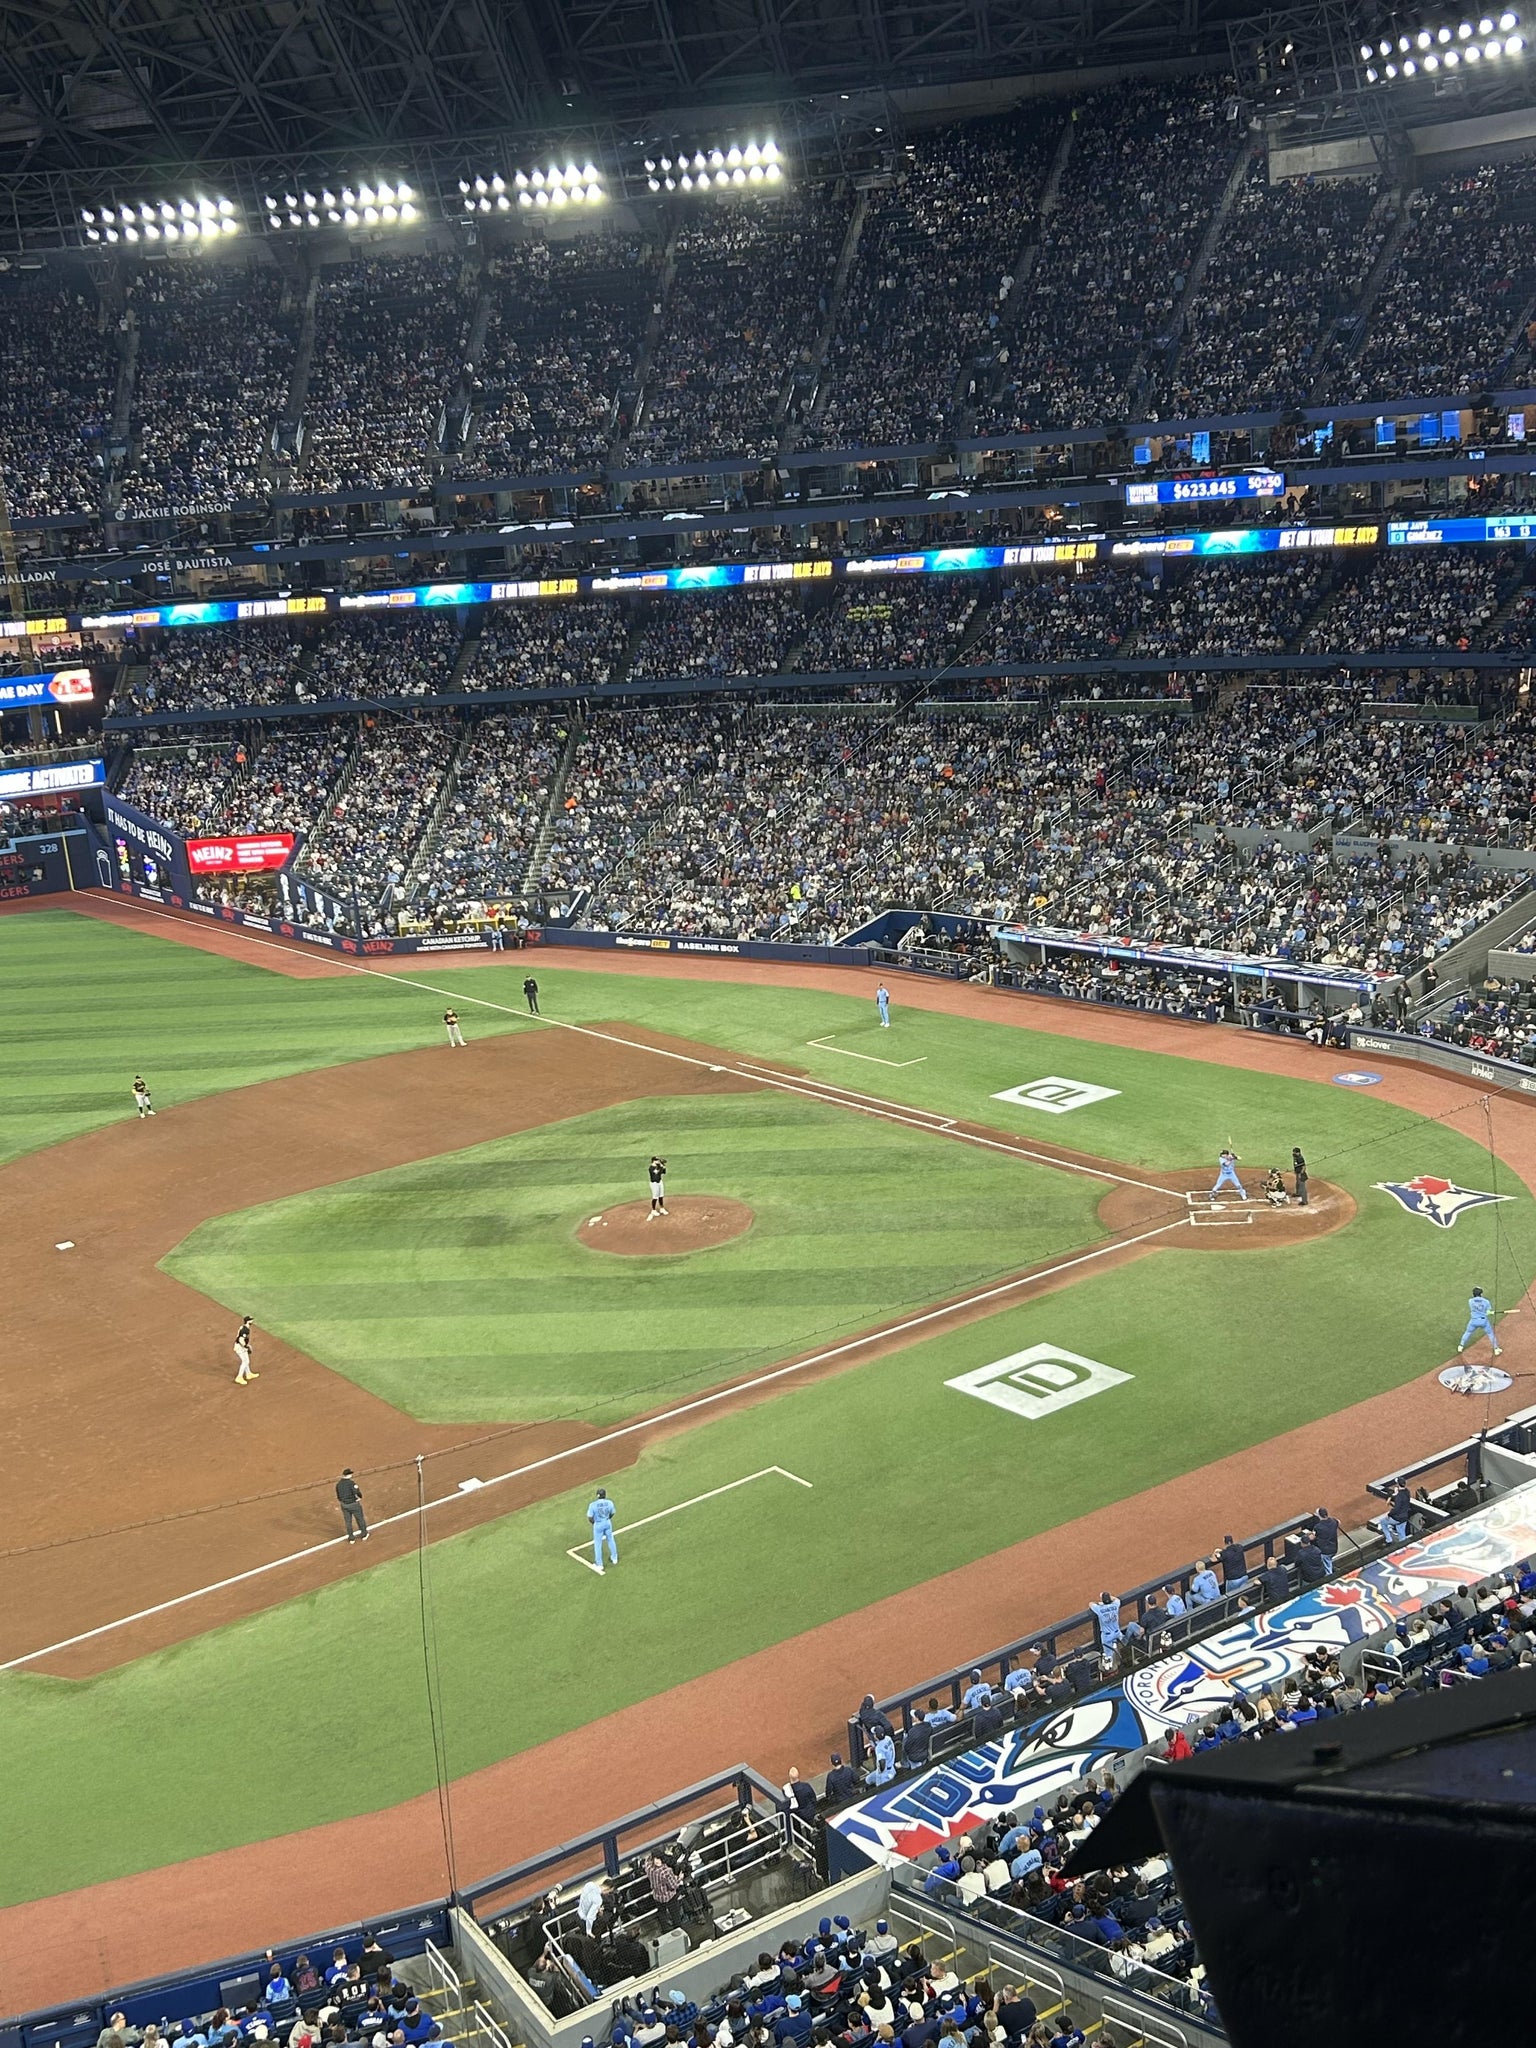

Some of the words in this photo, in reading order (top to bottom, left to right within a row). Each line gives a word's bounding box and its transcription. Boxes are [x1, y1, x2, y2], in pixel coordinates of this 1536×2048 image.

[1174, 481, 1236, 499] $623,845
[132, 507, 170, 520] JACKIE
[172, 502, 232, 516] ROBINSON
[1356, 526, 1378, 544] JAYS
[1165, 540, 1194, 552] BET
[141, 559, 170, 574] JOSÉ
[176, 557, 232, 570] BAUTISTA
[0, 571, 56, 584] HALLADAY
[307, 598, 325, 611] JAYS
[16, 683, 44, 698] DAY
[32, 764, 94, 790] ACTIVATED
[108, 808, 114, 823] IT
[114, 814, 128, 832] HAS
[128, 822, 137, 838] TO
[136, 828, 146, 843] BE
[146, 830, 172, 862] HEINZ
[40, 844, 58, 854] 328
[192, 845, 233, 863] HEINZ
[362, 940, 394, 953] HEINZ
[616, 936, 650, 946] theScore
[652, 940, 670, 948] BET
[678, 942, 720, 952] BASELINE
[1367, 1038, 1391, 1050] clover
[1472, 1068, 1494, 1080] KPMG
[1018, 1084, 1087, 1106] TD
[974, 1358, 1092, 1398] TD
